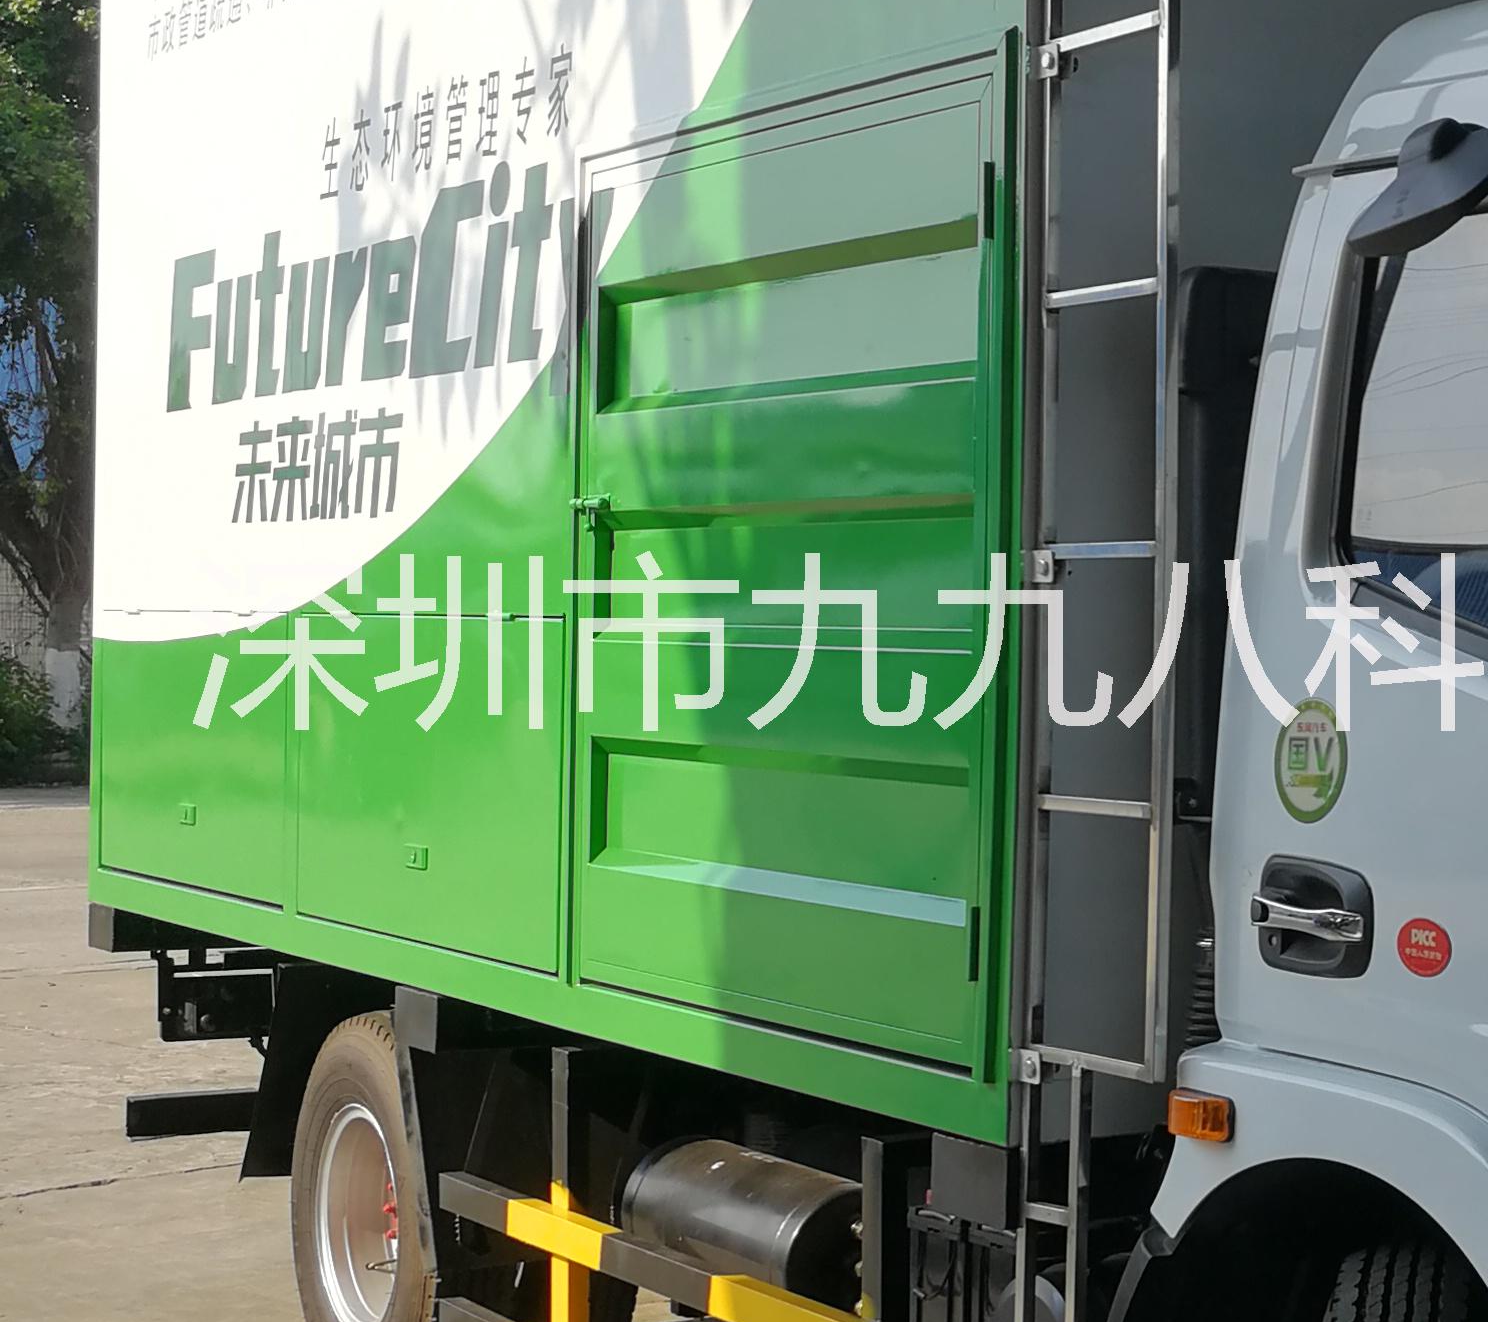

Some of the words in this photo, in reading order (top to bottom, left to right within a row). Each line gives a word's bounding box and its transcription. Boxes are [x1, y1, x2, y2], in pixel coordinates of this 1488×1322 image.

[319, 43, 574, 200] 生态环境管理专家
[231, 407, 404, 525] 未来城市
[1409, 927, 1438, 948] PICC
